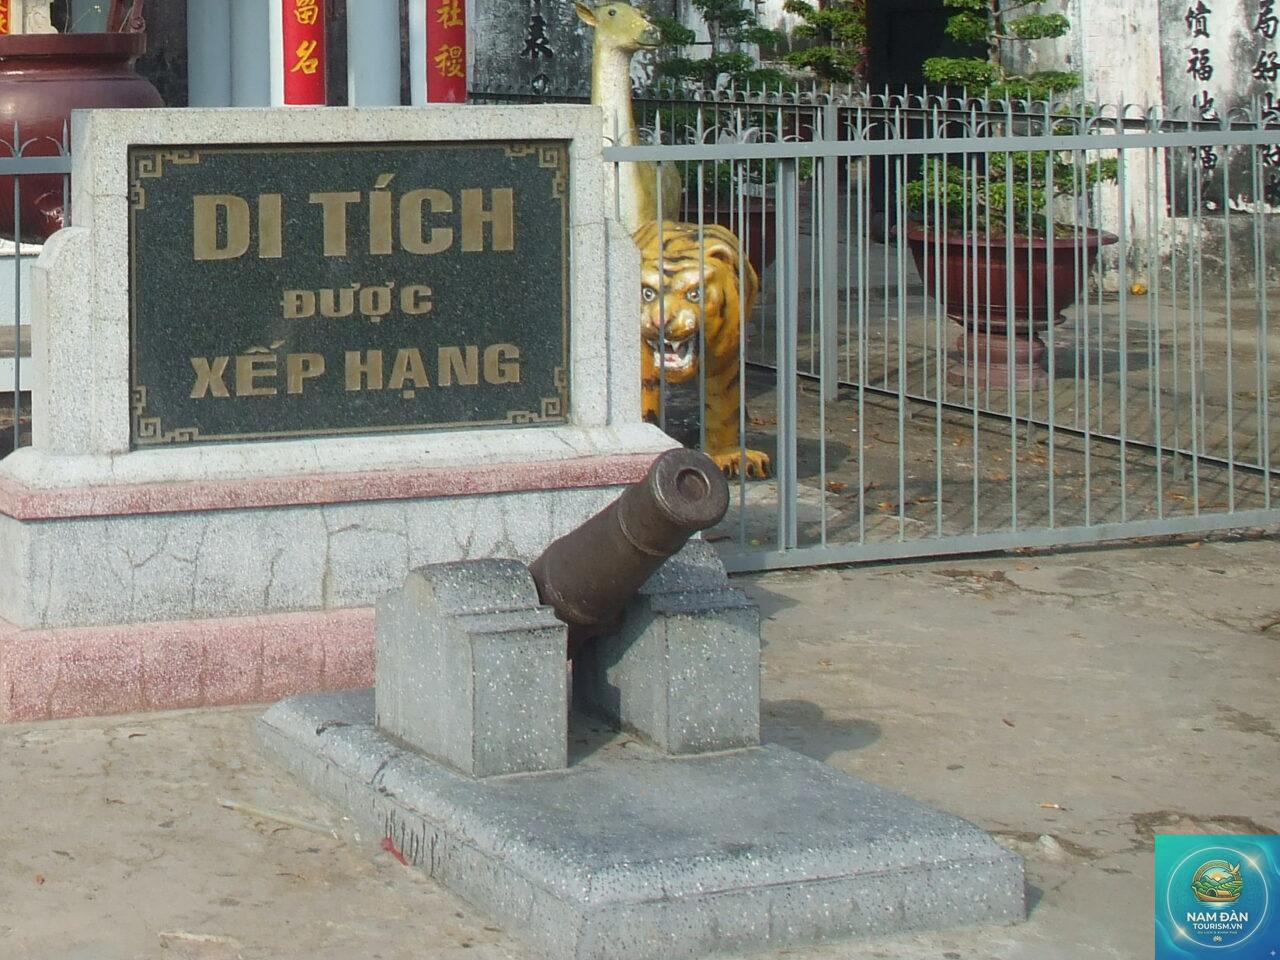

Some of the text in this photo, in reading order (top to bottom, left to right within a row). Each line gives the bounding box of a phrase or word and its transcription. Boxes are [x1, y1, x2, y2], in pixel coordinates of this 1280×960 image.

[193, 173, 515, 261] DI TÍCH
[281, 282, 433, 323] ĐƯỢC
[191, 340, 521, 399] XẾP HẠNG
